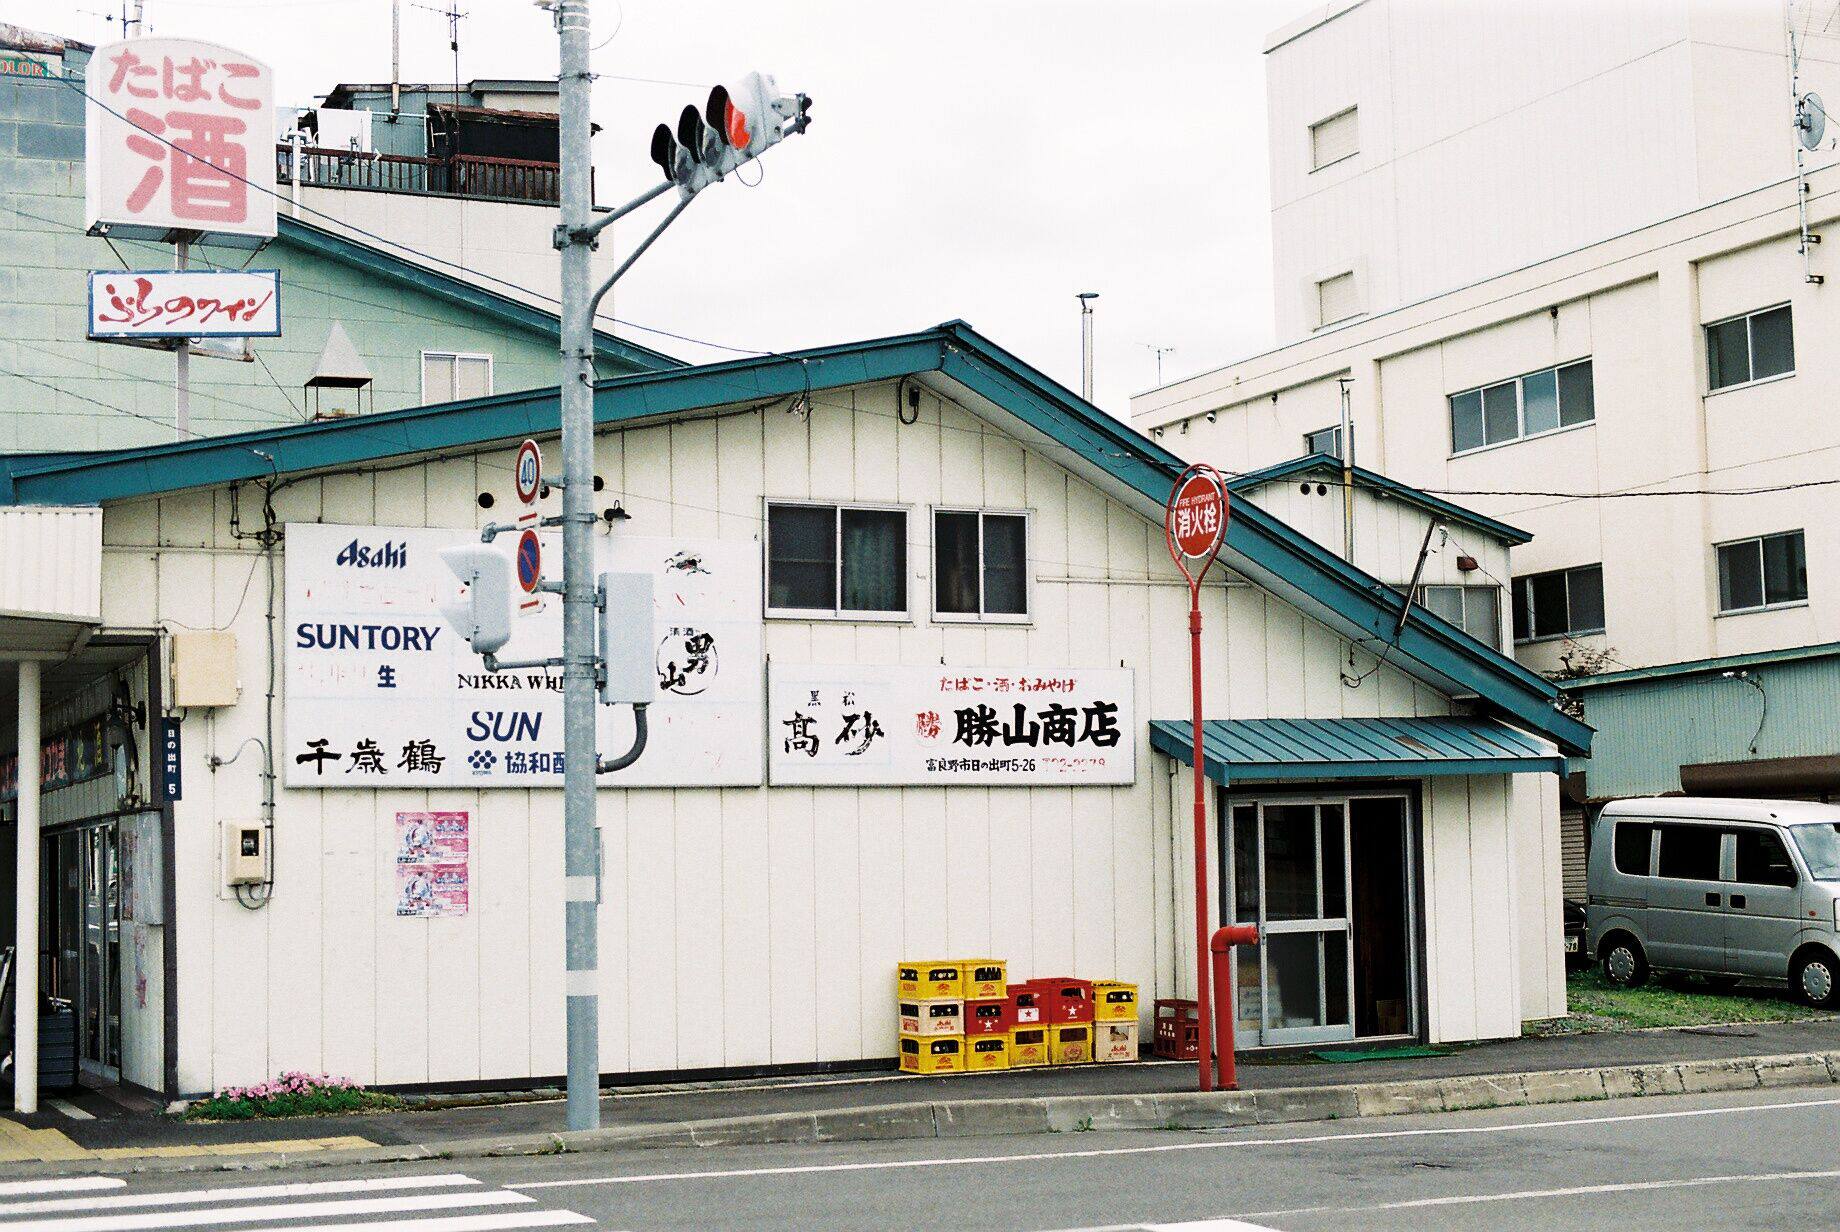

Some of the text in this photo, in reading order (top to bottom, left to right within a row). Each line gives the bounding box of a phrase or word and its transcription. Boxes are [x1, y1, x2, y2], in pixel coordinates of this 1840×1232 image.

[108, 48, 262, 111] たばこ
[125, 107, 247, 224] 酒
[98, 276, 273, 328] ふらのワイン
[521, 458, 535, 485] 40
[1177, 502, 1217, 539] 消火栓
[336, 538, 407, 569] Asahi
[296, 623, 441, 651] SUNTORY
[377, 665, 397, 688] 生
[458, 673, 522, 690] NIKKA
[466, 711, 543, 742] SUN
[952, 700, 1121, 748] 勝山商店
[167, 729, 177, 795] 日の出町 5
[296, 738, 446, 776] 千歳鶴
[925, 757, 1036, 773] 富良野市日の出町5-26
